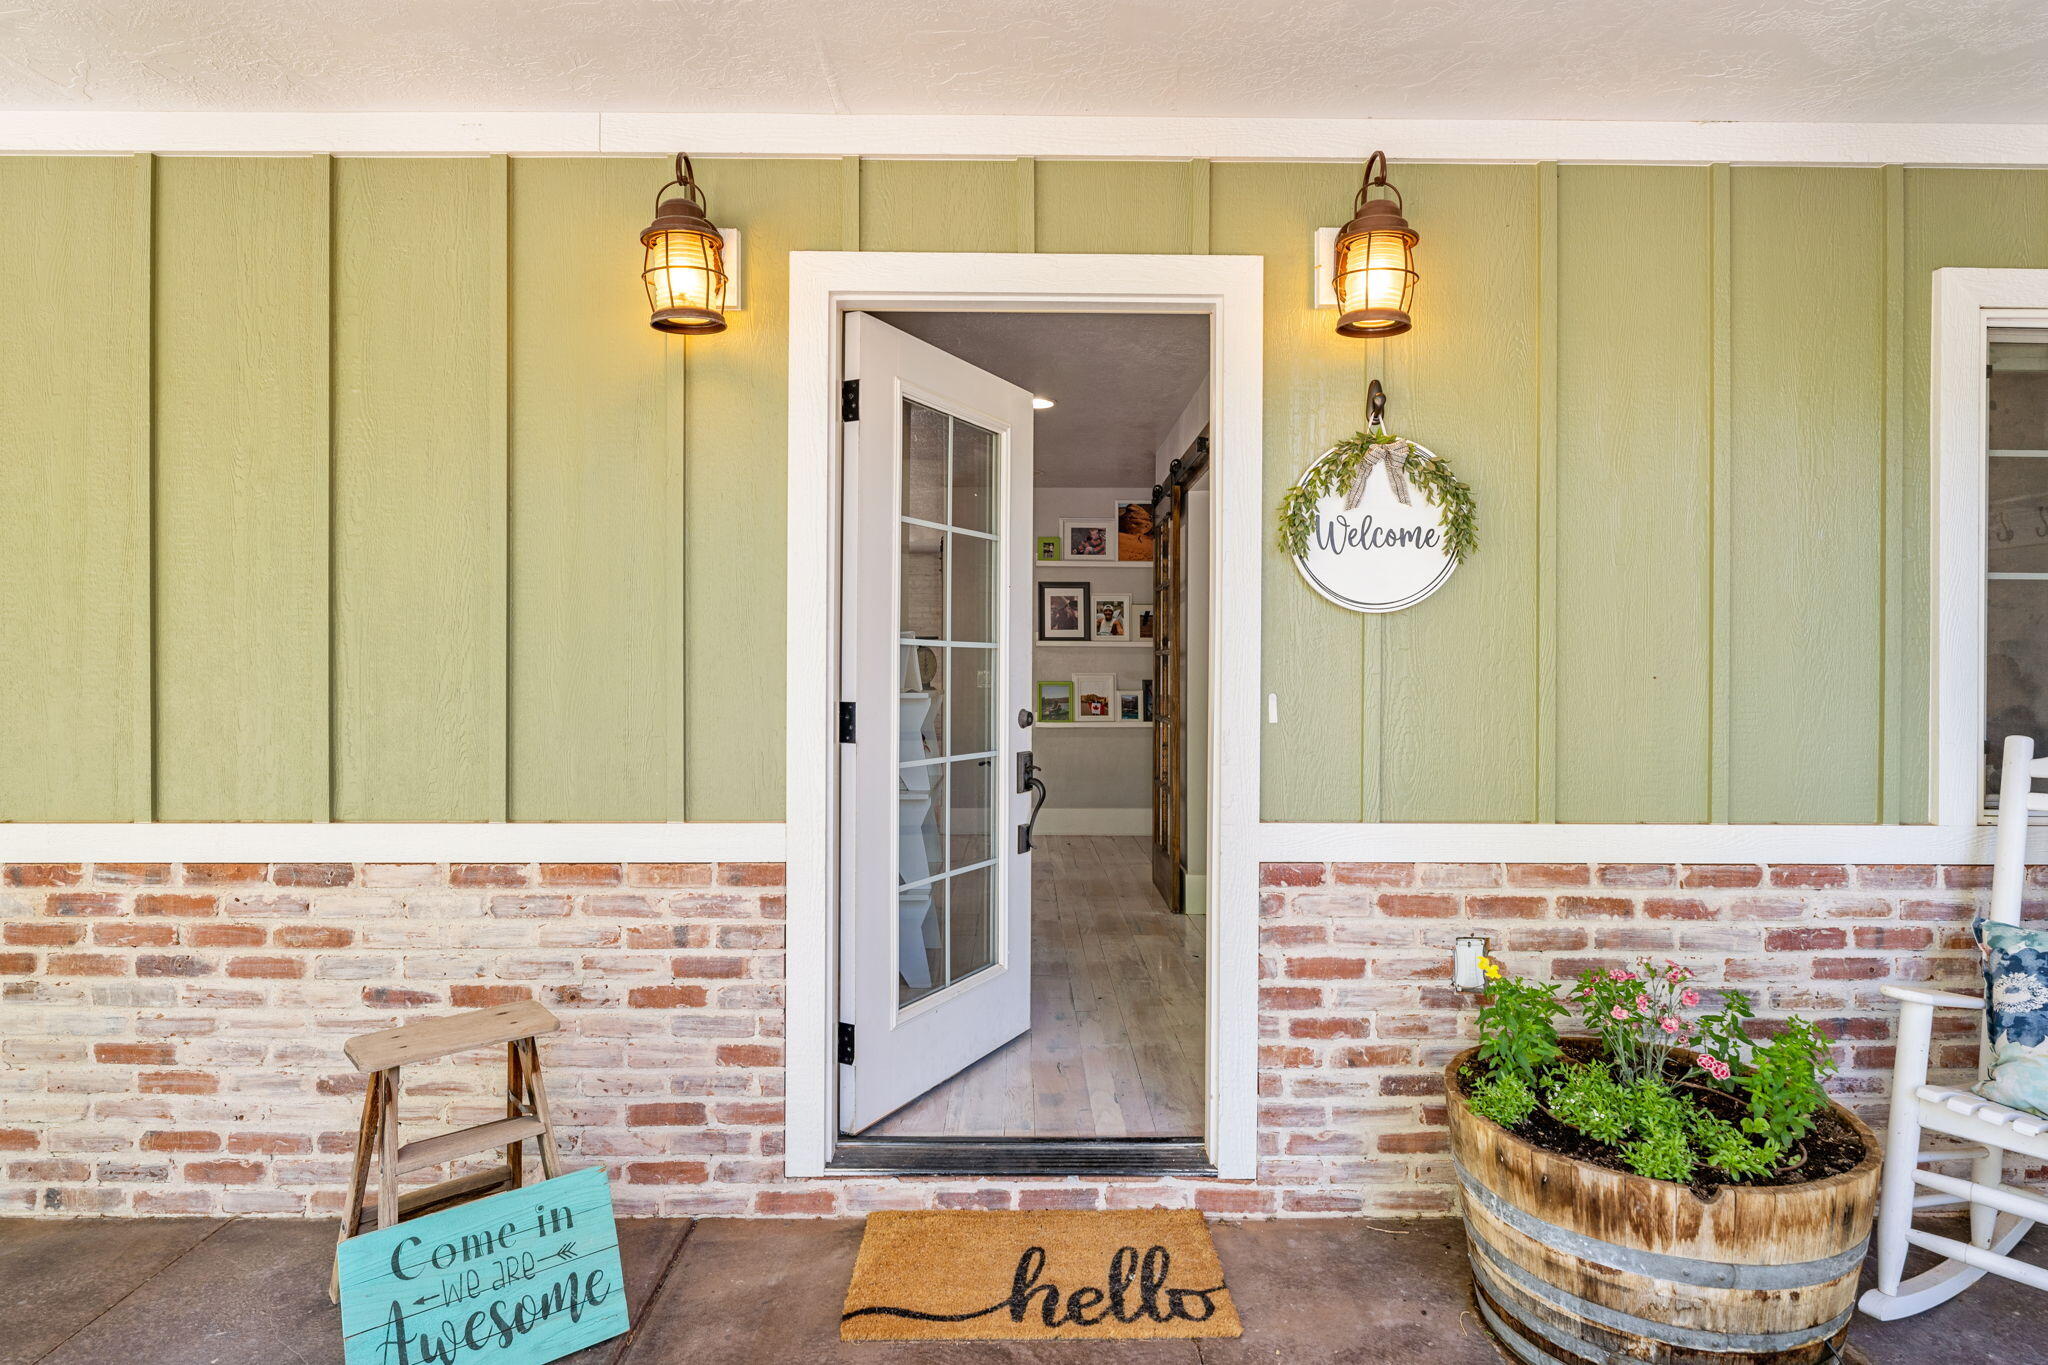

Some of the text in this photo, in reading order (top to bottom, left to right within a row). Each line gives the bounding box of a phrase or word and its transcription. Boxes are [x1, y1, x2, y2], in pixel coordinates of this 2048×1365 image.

[1314, 514, 1440, 555] Welcome
[391, 1204, 574, 1281] Come in
[375, 1269, 611, 1365] Awesome
[1008, 1246, 1224, 1328] hello
